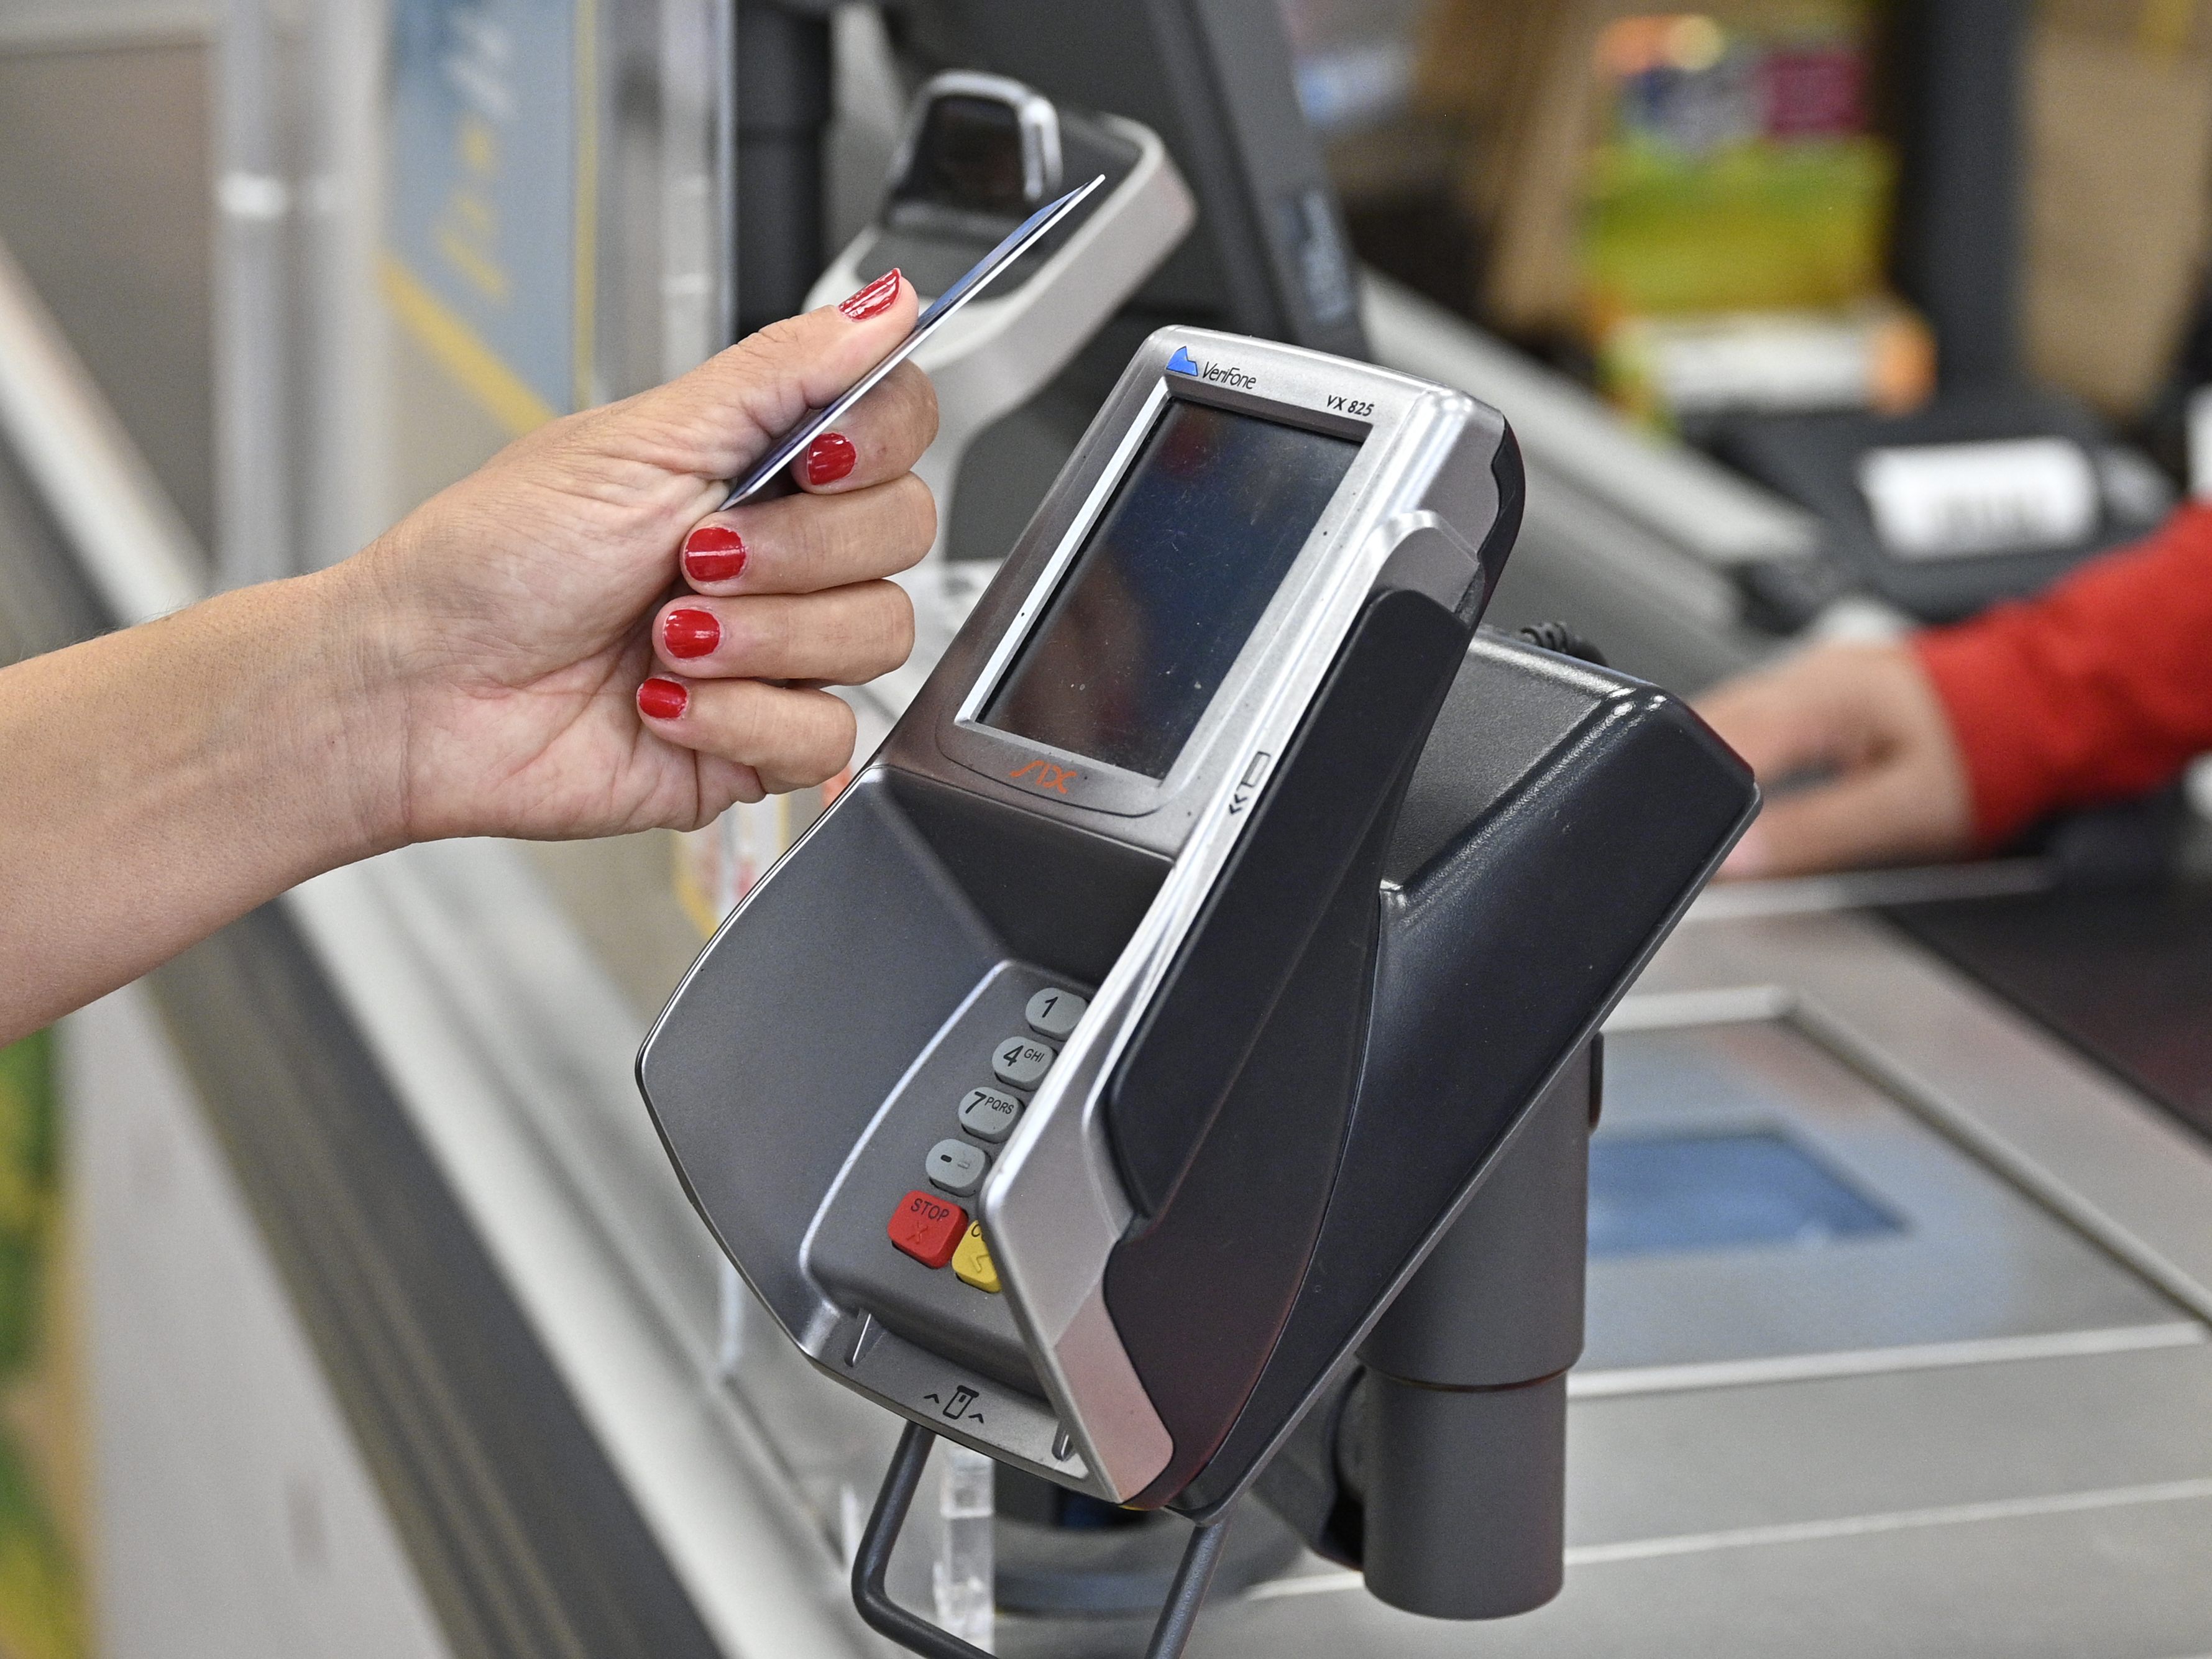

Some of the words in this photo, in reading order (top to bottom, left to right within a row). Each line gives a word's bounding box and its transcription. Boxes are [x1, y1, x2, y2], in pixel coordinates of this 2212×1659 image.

[1202, 361, 1257, 390] VeriFone
[1326, 395, 1347, 411] VX
[1347, 400, 1375, 417] 825
[1042, 996, 1058, 1018] 1
[1003, 1045, 1024, 1067] 4
[1024, 1048, 1045, 1063] GHI
[965, 1091, 987, 1114] 7
[984, 1096, 1014, 1114] PQRS
[911, 1198, 950, 1222] STOP
